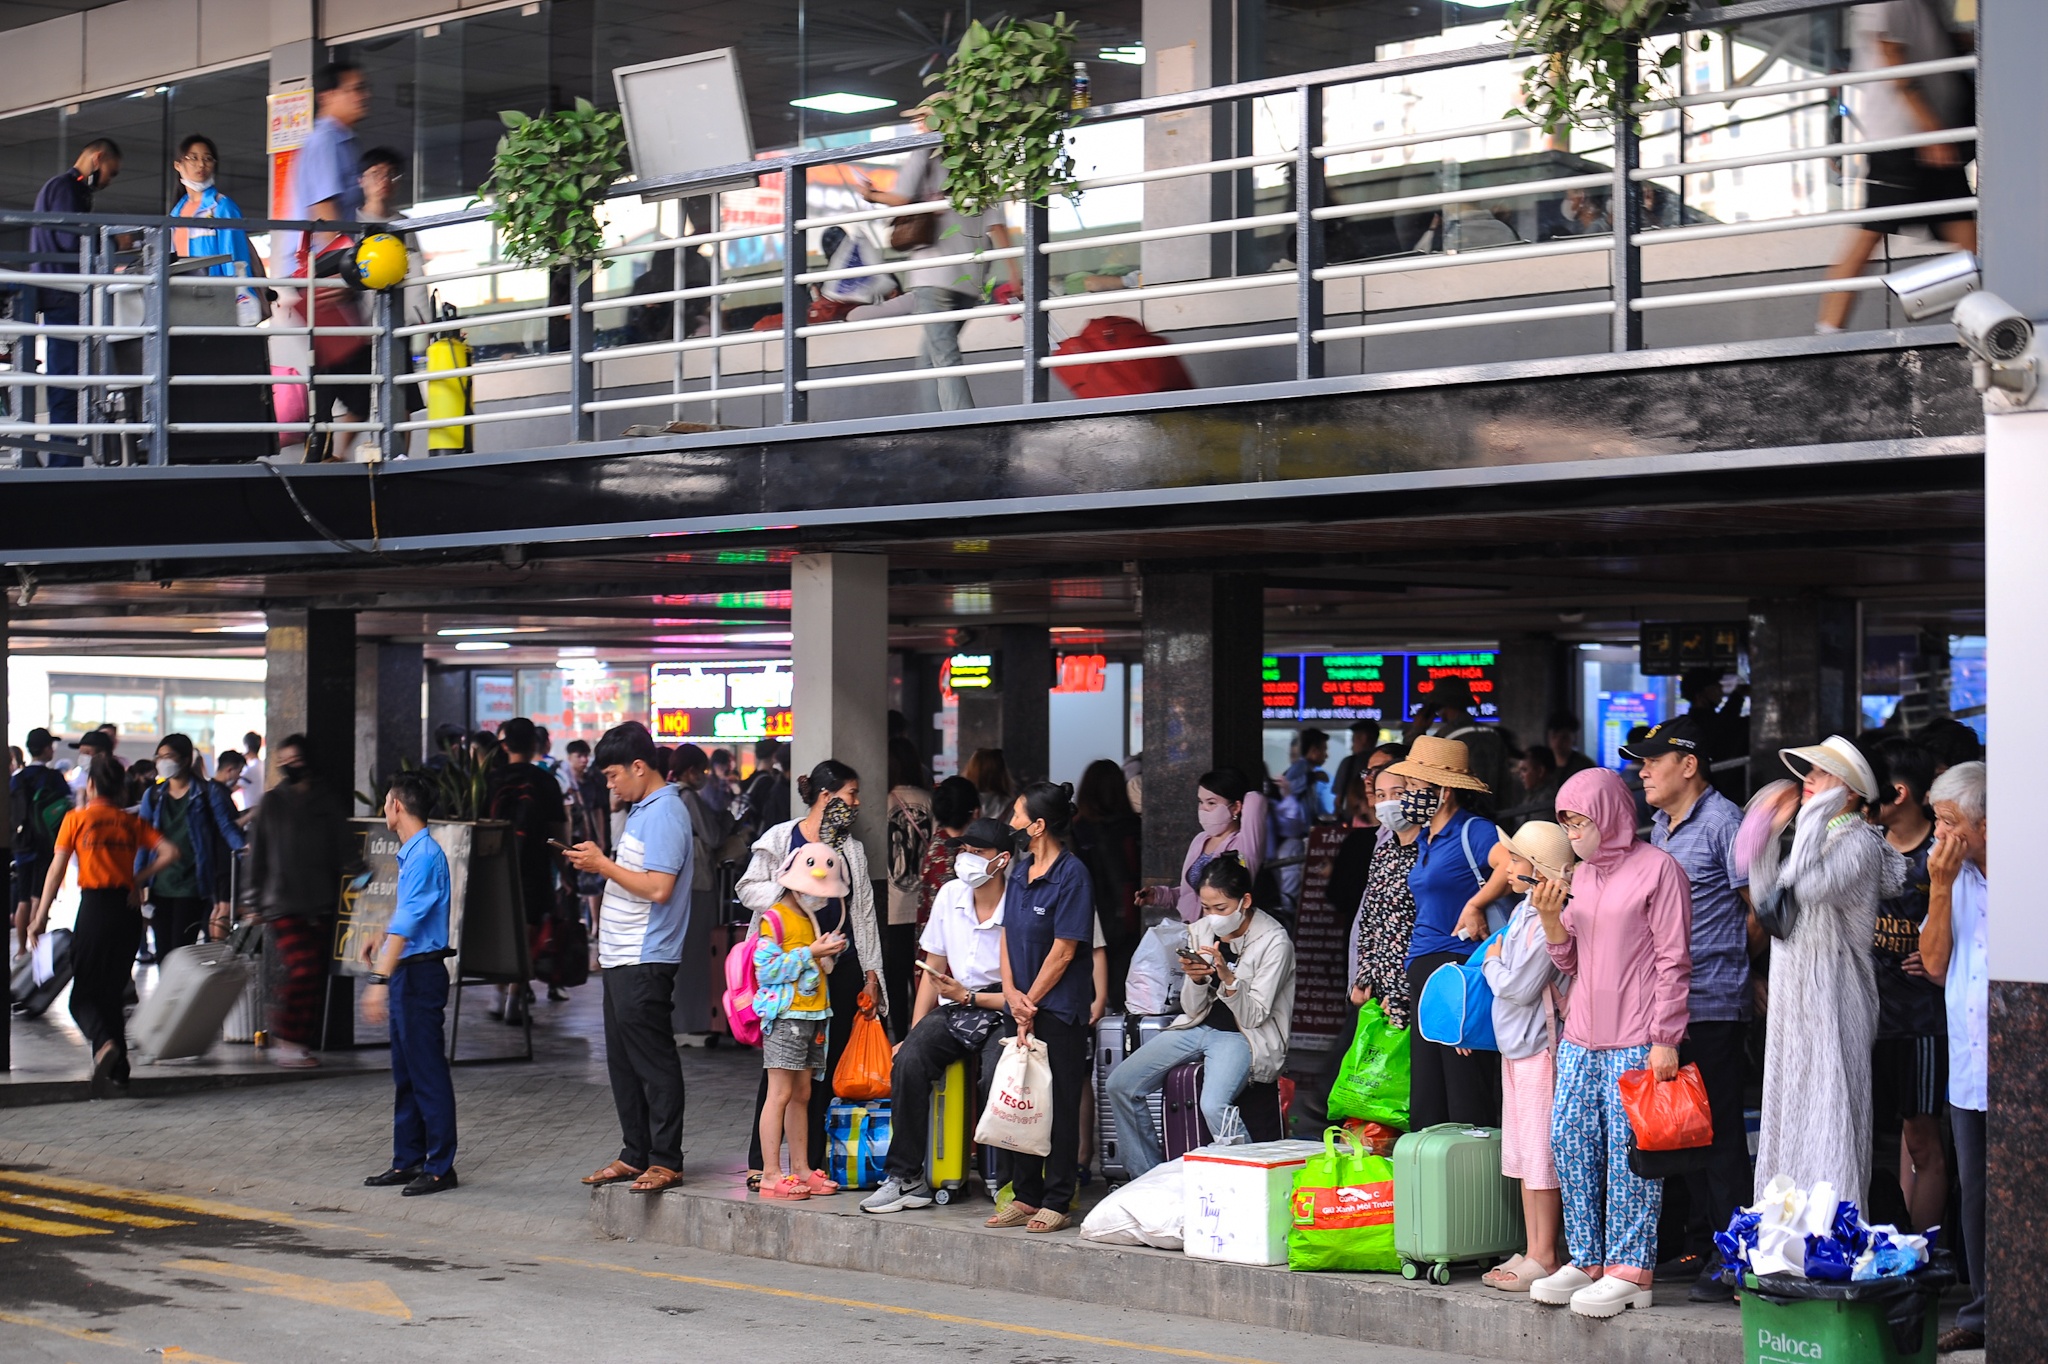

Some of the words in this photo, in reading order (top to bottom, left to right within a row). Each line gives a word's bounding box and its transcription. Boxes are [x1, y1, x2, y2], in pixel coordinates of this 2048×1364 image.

[663, 709, 690, 736] NỘI
[766, 711, 793, 736] :15
[380, 877, 398, 895] BÚY
[999, 1090, 1034, 1111] TESOL
[1336, 1203, 1356, 1214] Xanh
[1373, 1198, 1394, 1209] Trườn
[1758, 1328, 1822, 1360] Paloca
